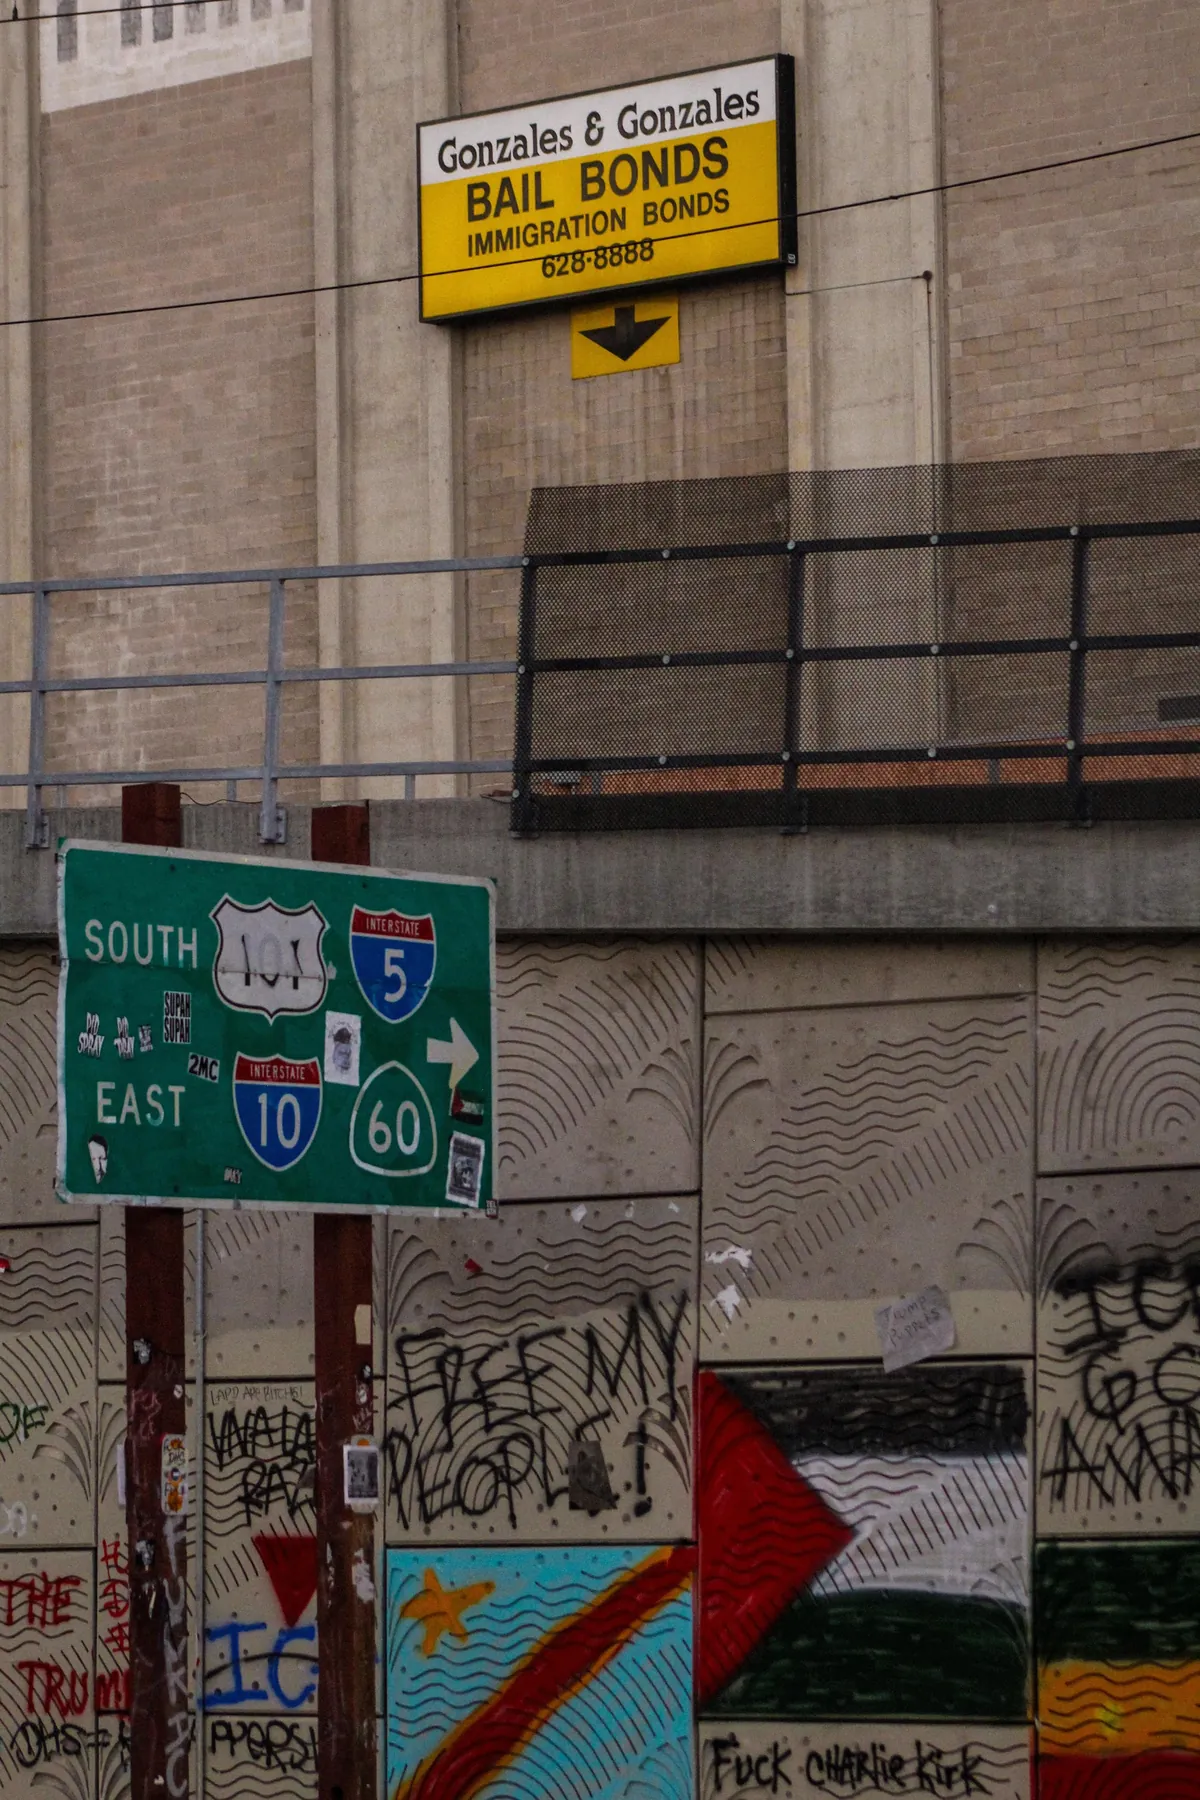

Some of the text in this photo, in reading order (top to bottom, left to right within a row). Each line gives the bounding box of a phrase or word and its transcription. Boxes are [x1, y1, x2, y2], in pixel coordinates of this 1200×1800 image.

[438, 87, 760, 174] Gonzales & Gonzales
[467, 136, 729, 222] BAIL BONDS
[468, 188, 729, 257] IMMIGRATION BONDS
[84, 919, 198, 969] SOUTH
[365, 916, 421, 936] INTERSTATE
[384, 948, 407, 1003] 5
[188, 1053, 219, 1081] 2MC
[249, 1063, 306, 1081] INTERSTATE
[97, 1081, 186, 1127] EAST
[258, 1093, 301, 1149] 10
[368, 1100, 421, 1155] 60
[0, 1570, 82, 1628] THE
